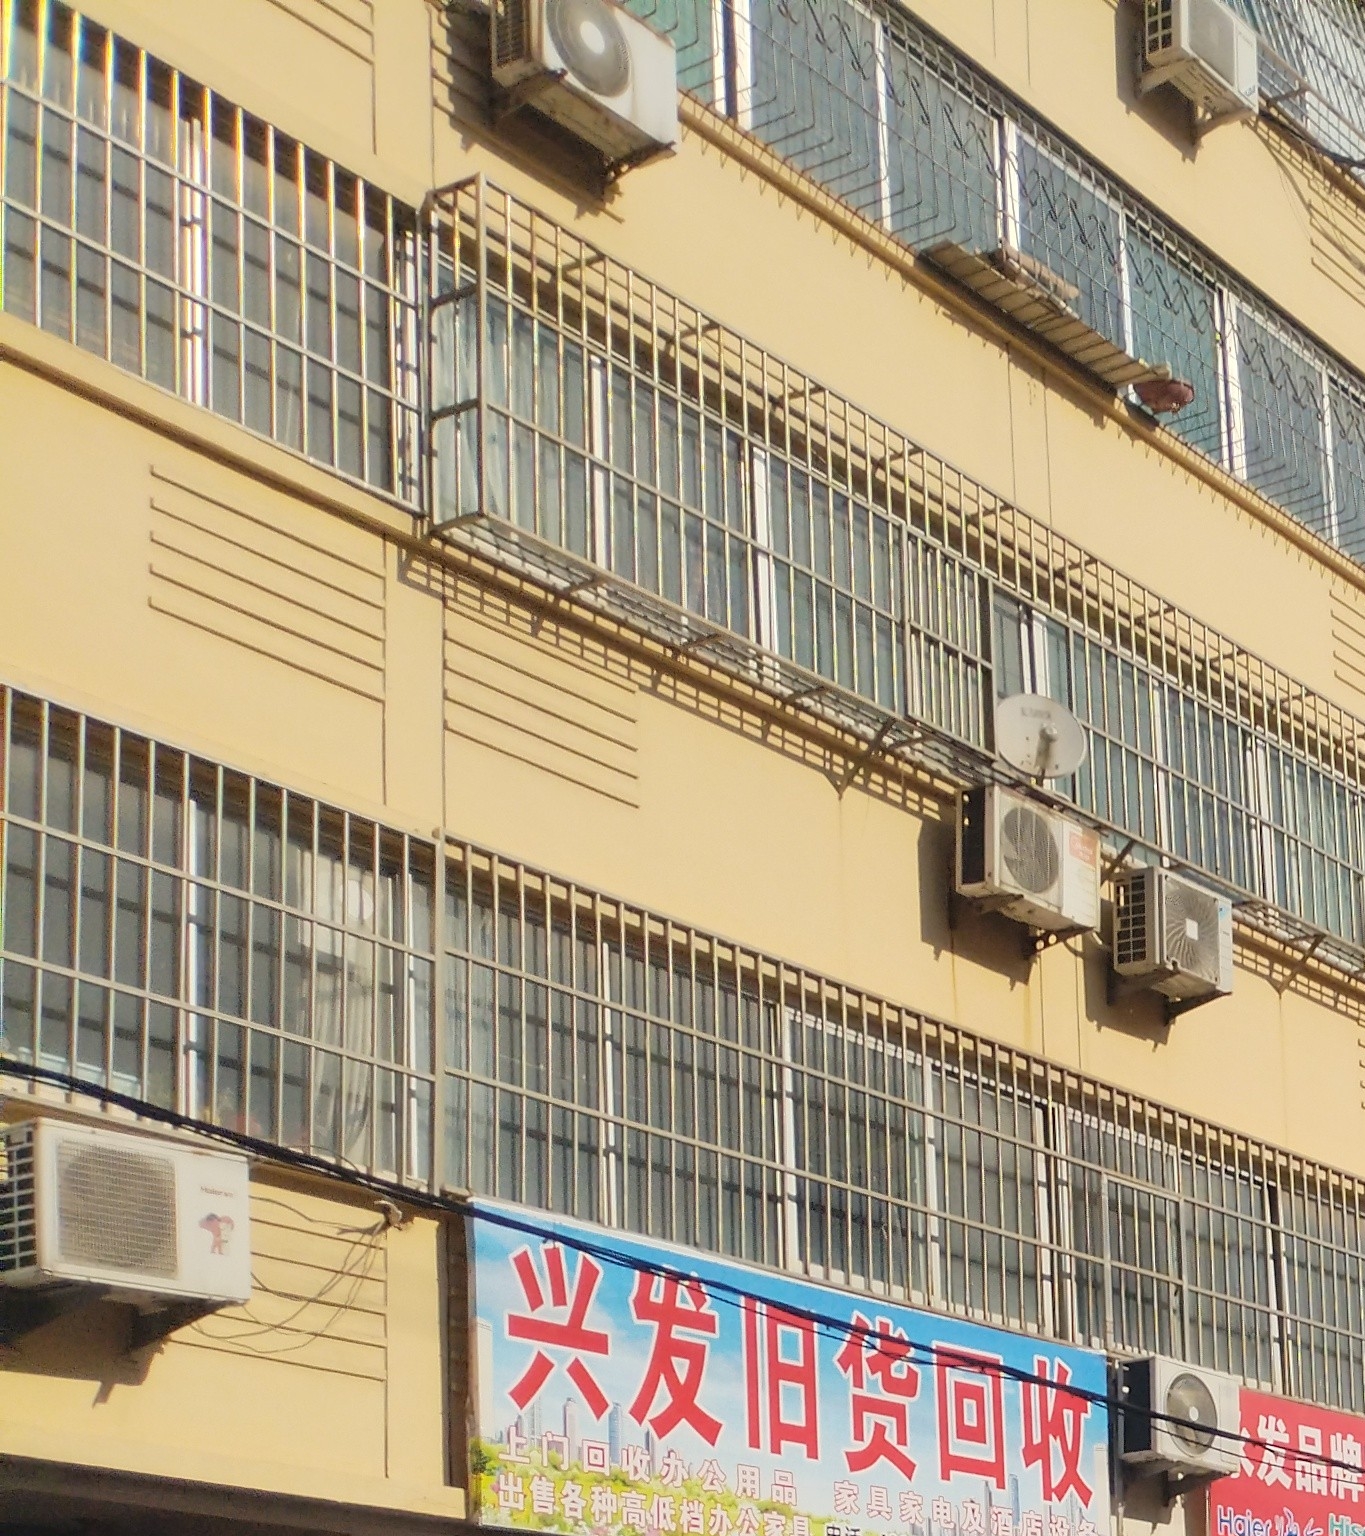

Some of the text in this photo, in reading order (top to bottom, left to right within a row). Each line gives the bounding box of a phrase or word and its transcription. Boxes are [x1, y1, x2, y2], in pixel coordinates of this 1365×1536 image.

[505, 1242, 1094, 1509] 兴发旧货回收
[499, 1426, 798, 1506] 上门回收办公用品
